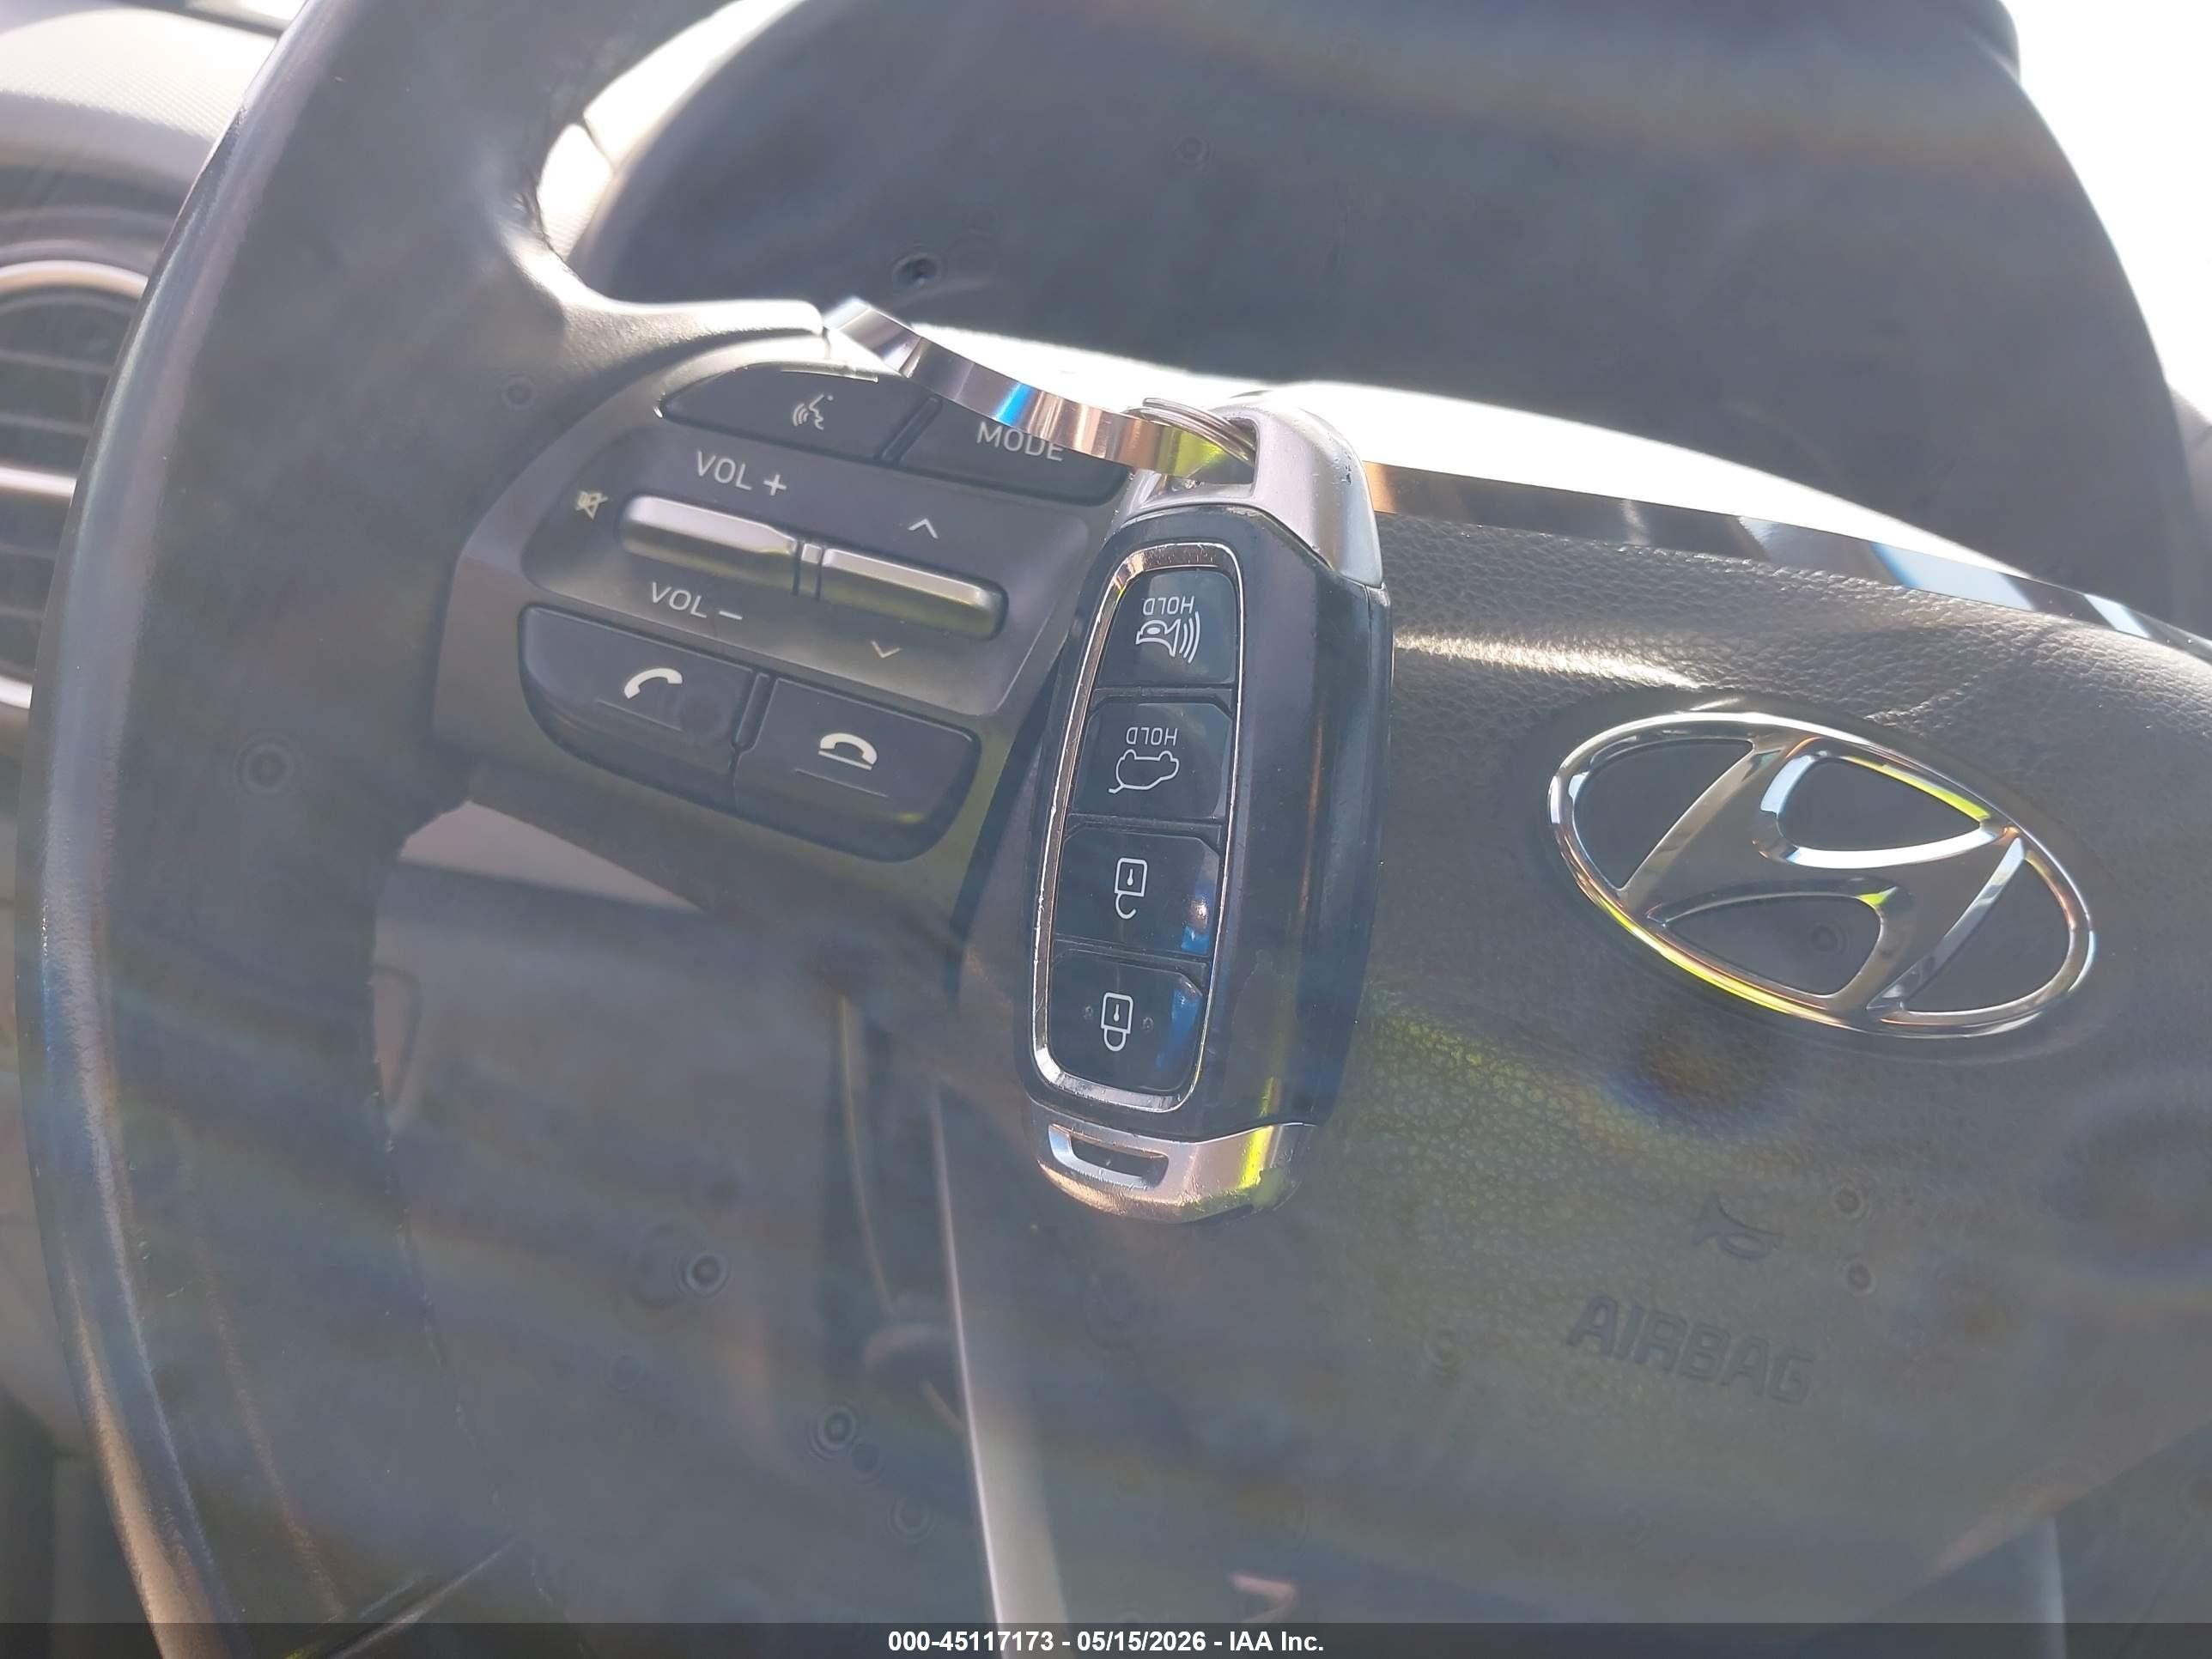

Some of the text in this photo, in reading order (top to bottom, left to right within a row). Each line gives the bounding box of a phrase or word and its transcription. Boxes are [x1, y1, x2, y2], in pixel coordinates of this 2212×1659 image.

[975, 421, 1065, 462] MODE
[695, 450, 752, 492] VOL
[650, 581, 708, 619] VOL
[1142, 595, 1195, 616] HOLD
[1126, 726, 1178, 746] HOLD
[1565, 1294, 1814, 1405] AIRBAG
